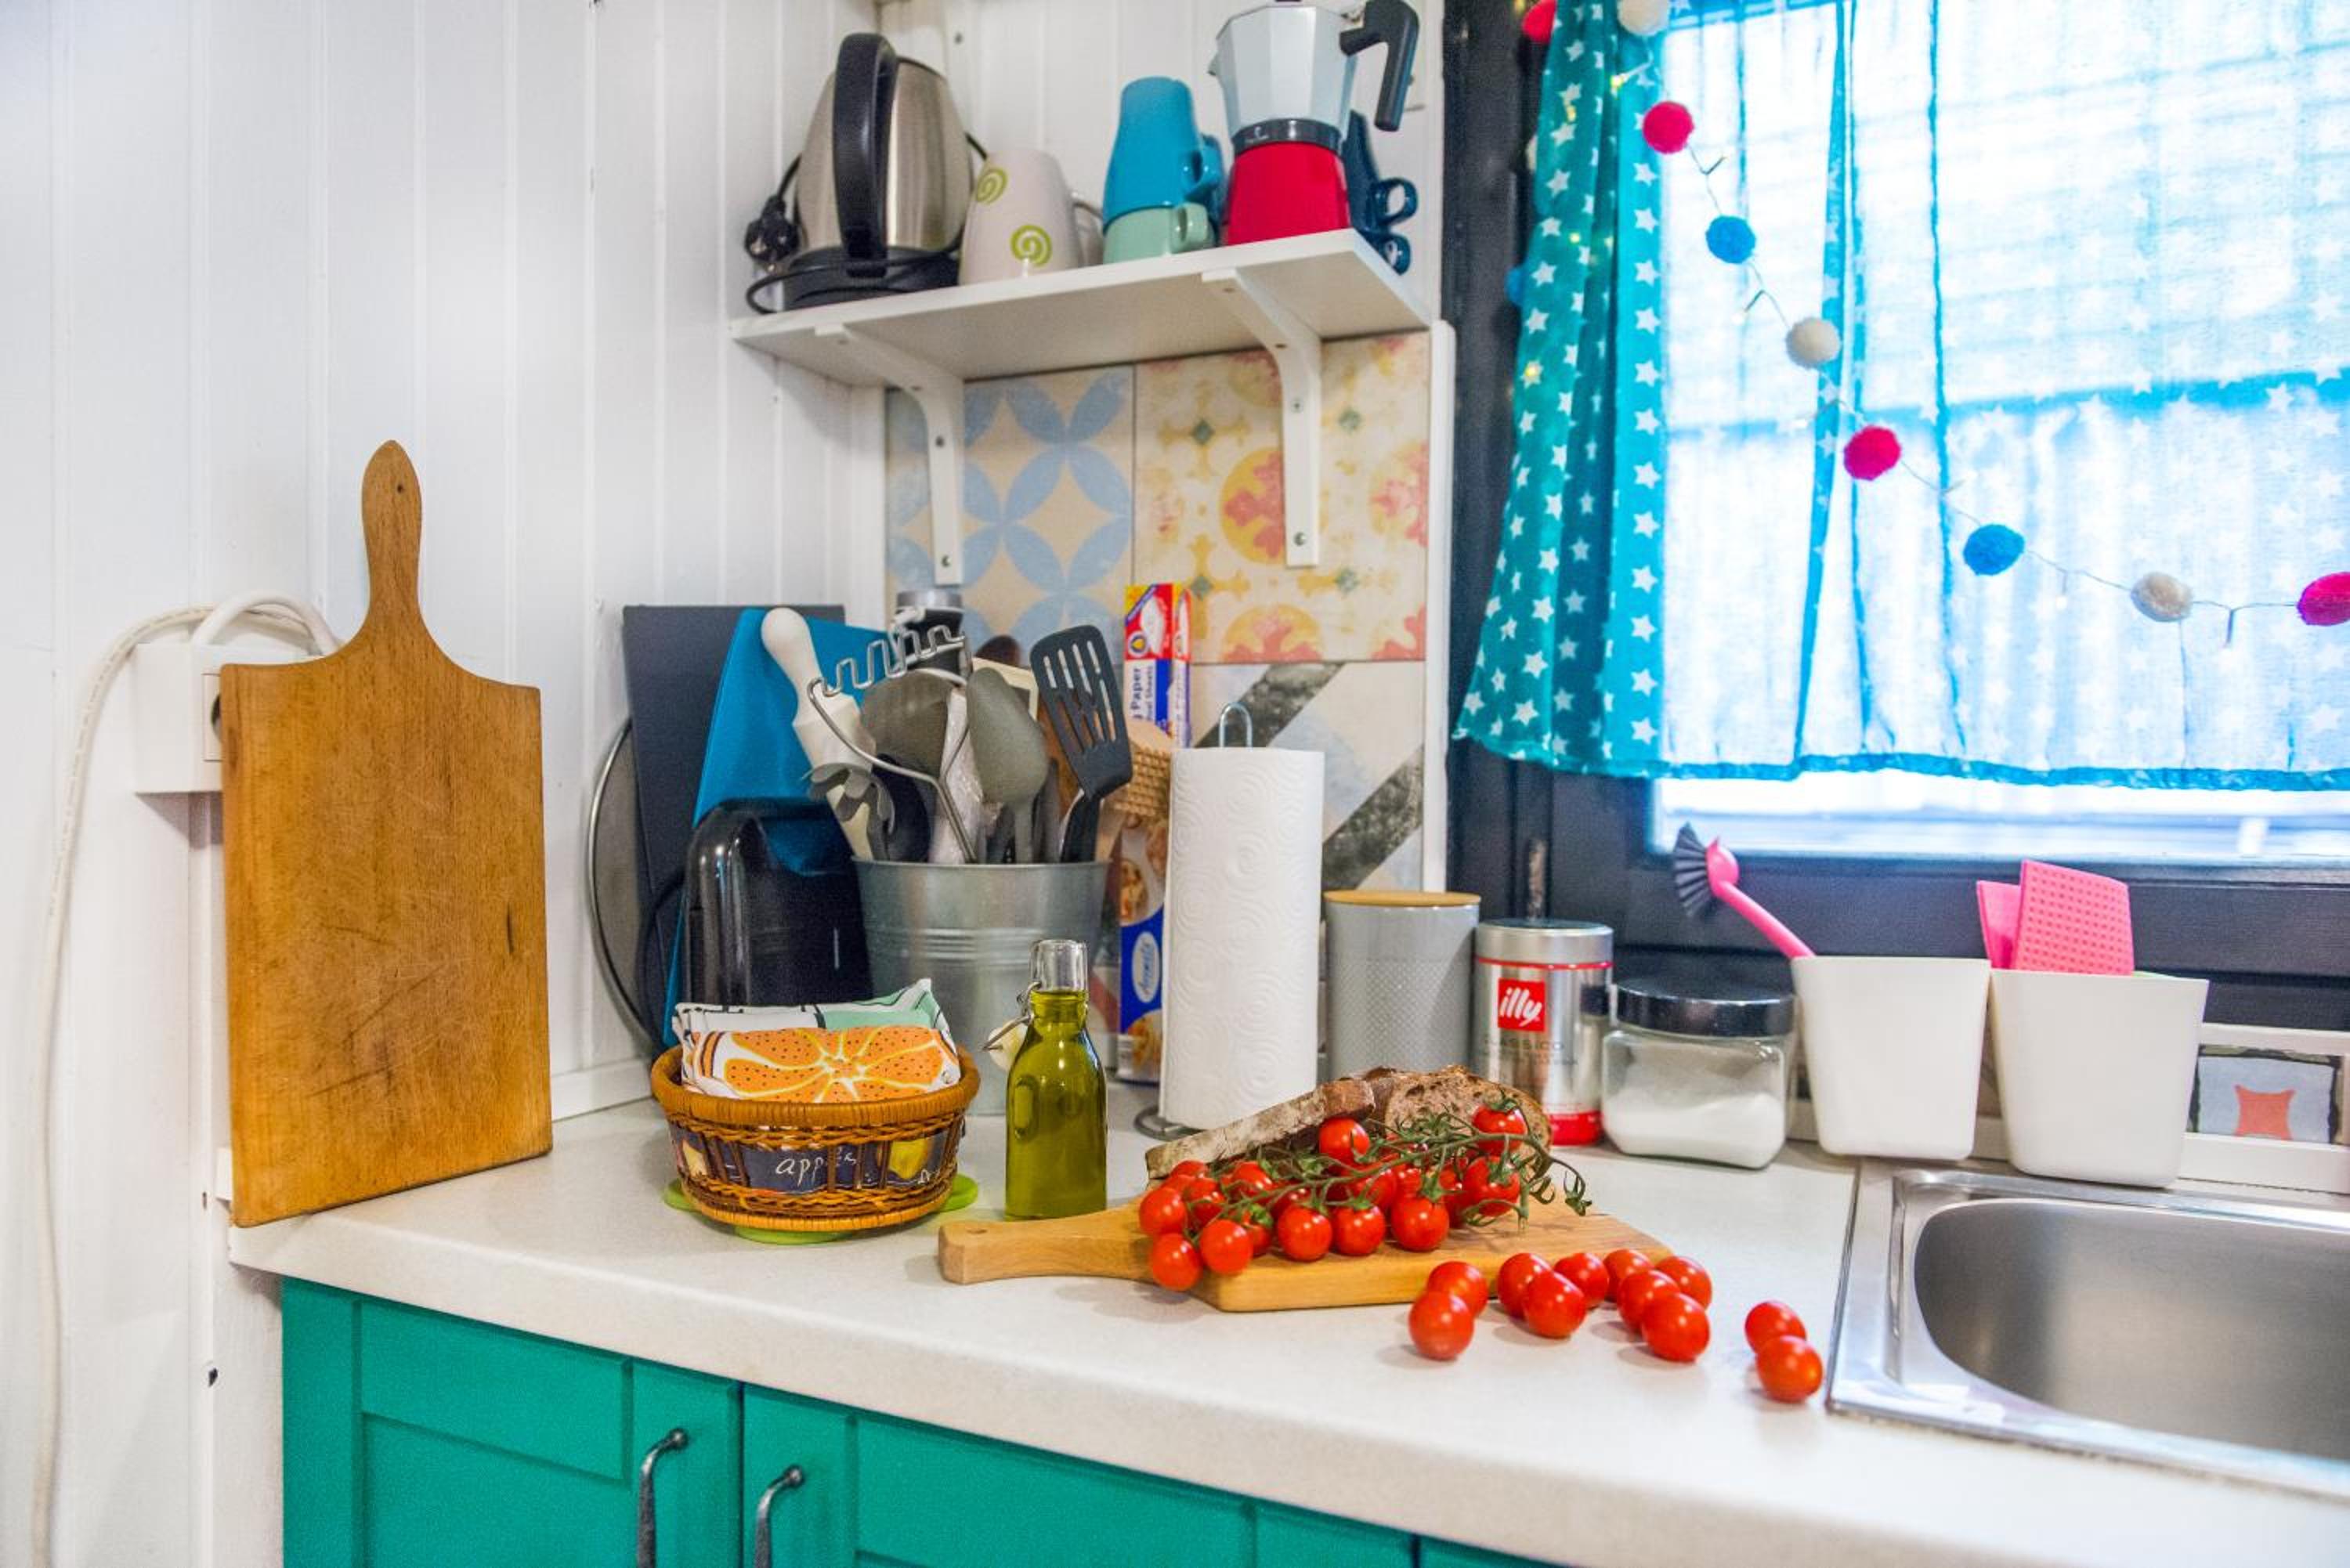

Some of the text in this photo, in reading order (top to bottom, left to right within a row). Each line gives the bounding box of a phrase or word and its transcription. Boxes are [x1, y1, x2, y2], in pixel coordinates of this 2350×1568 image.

[1130, 668, 1143, 710] Paper
[1499, 987, 1542, 1028] illy
[775, 1147, 856, 1187] apps
